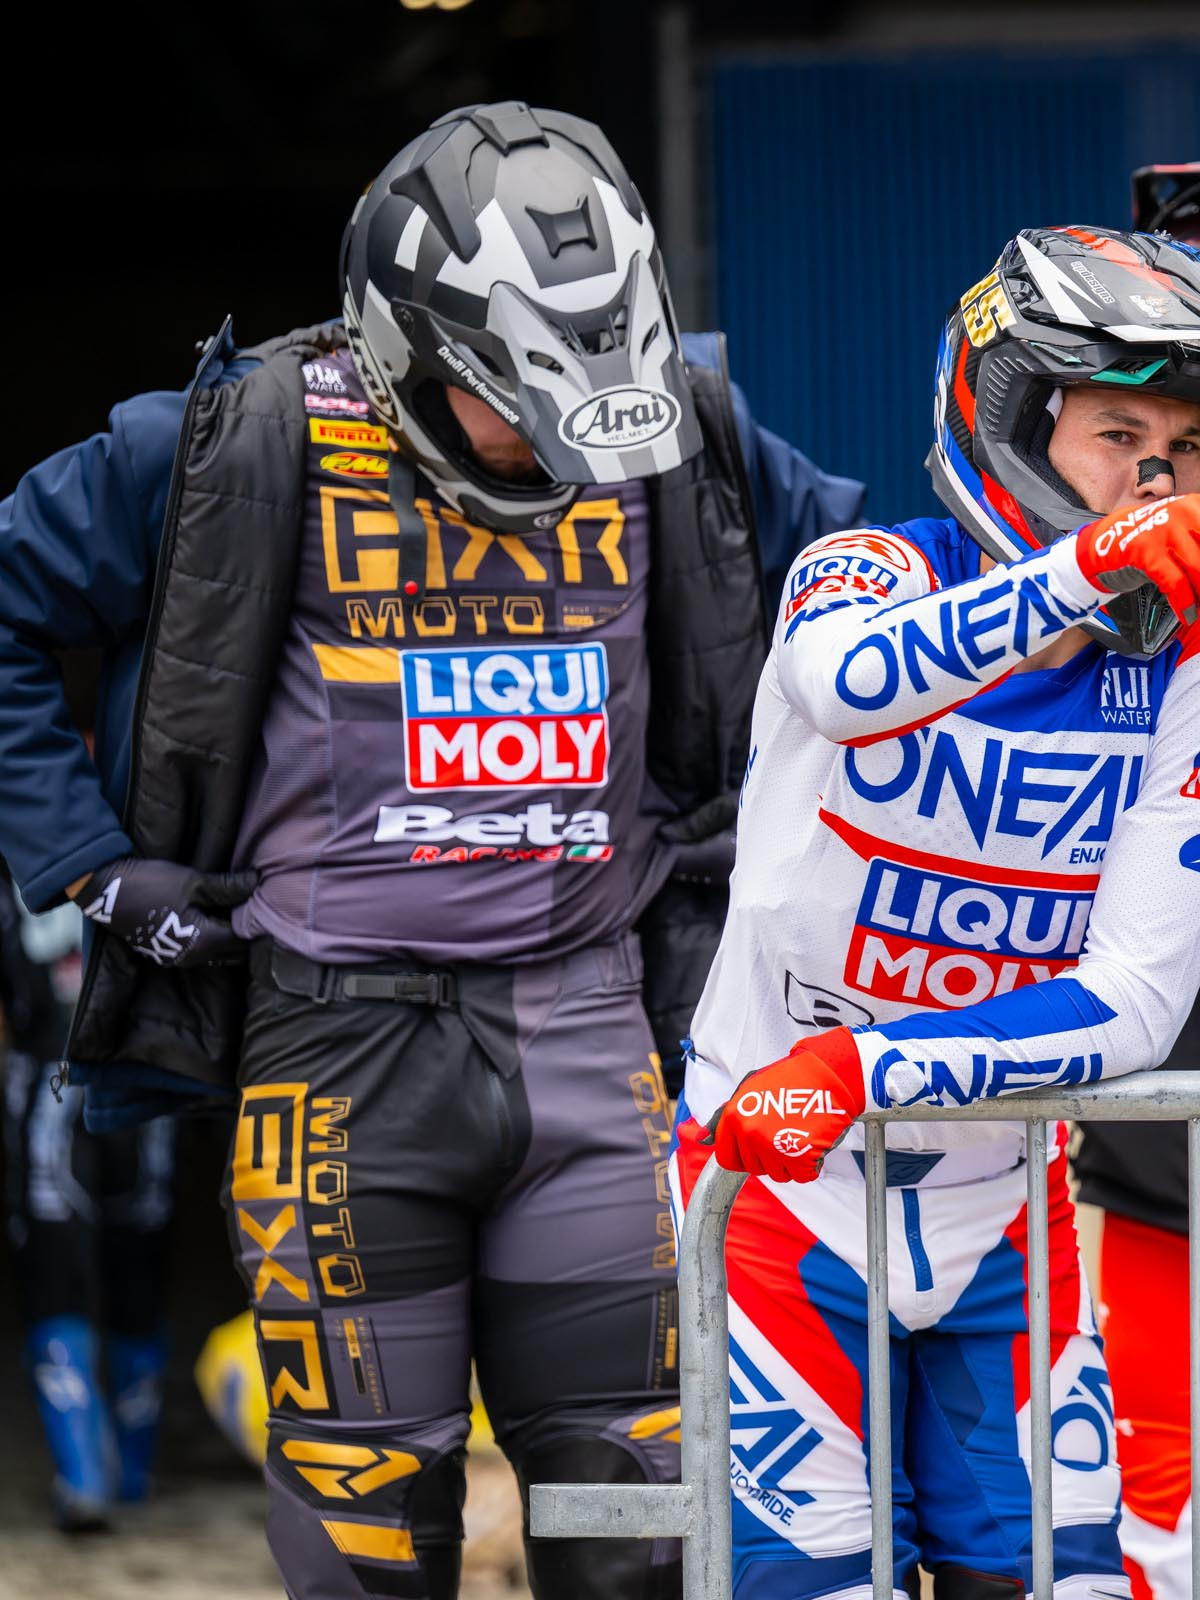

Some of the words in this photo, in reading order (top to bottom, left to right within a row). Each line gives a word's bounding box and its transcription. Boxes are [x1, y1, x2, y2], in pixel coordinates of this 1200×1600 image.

[306, 380, 348, 393] WATER
[437, 345, 467, 373] Drudi
[461, 368, 520, 425] Performance
[575, 392, 665, 441] Arai
[792, 556, 893, 597] LIQUI
[346, 596, 545, 638] MOTO
[414, 651, 600, 715] LIQUI
[1101, 667, 1151, 709] FIJI
[1101, 710, 1152, 726] WATER
[418, 719, 604, 783] MOLY
[373, 802, 610, 846] Beta
[408, 846, 564, 863] RACING
[869, 868, 1093, 954] LIQUI
[736, 1087, 847, 1121] O'NEAL
[307, 1095, 367, 1297] MOTO
[231, 1081, 329, 1411] FXR
